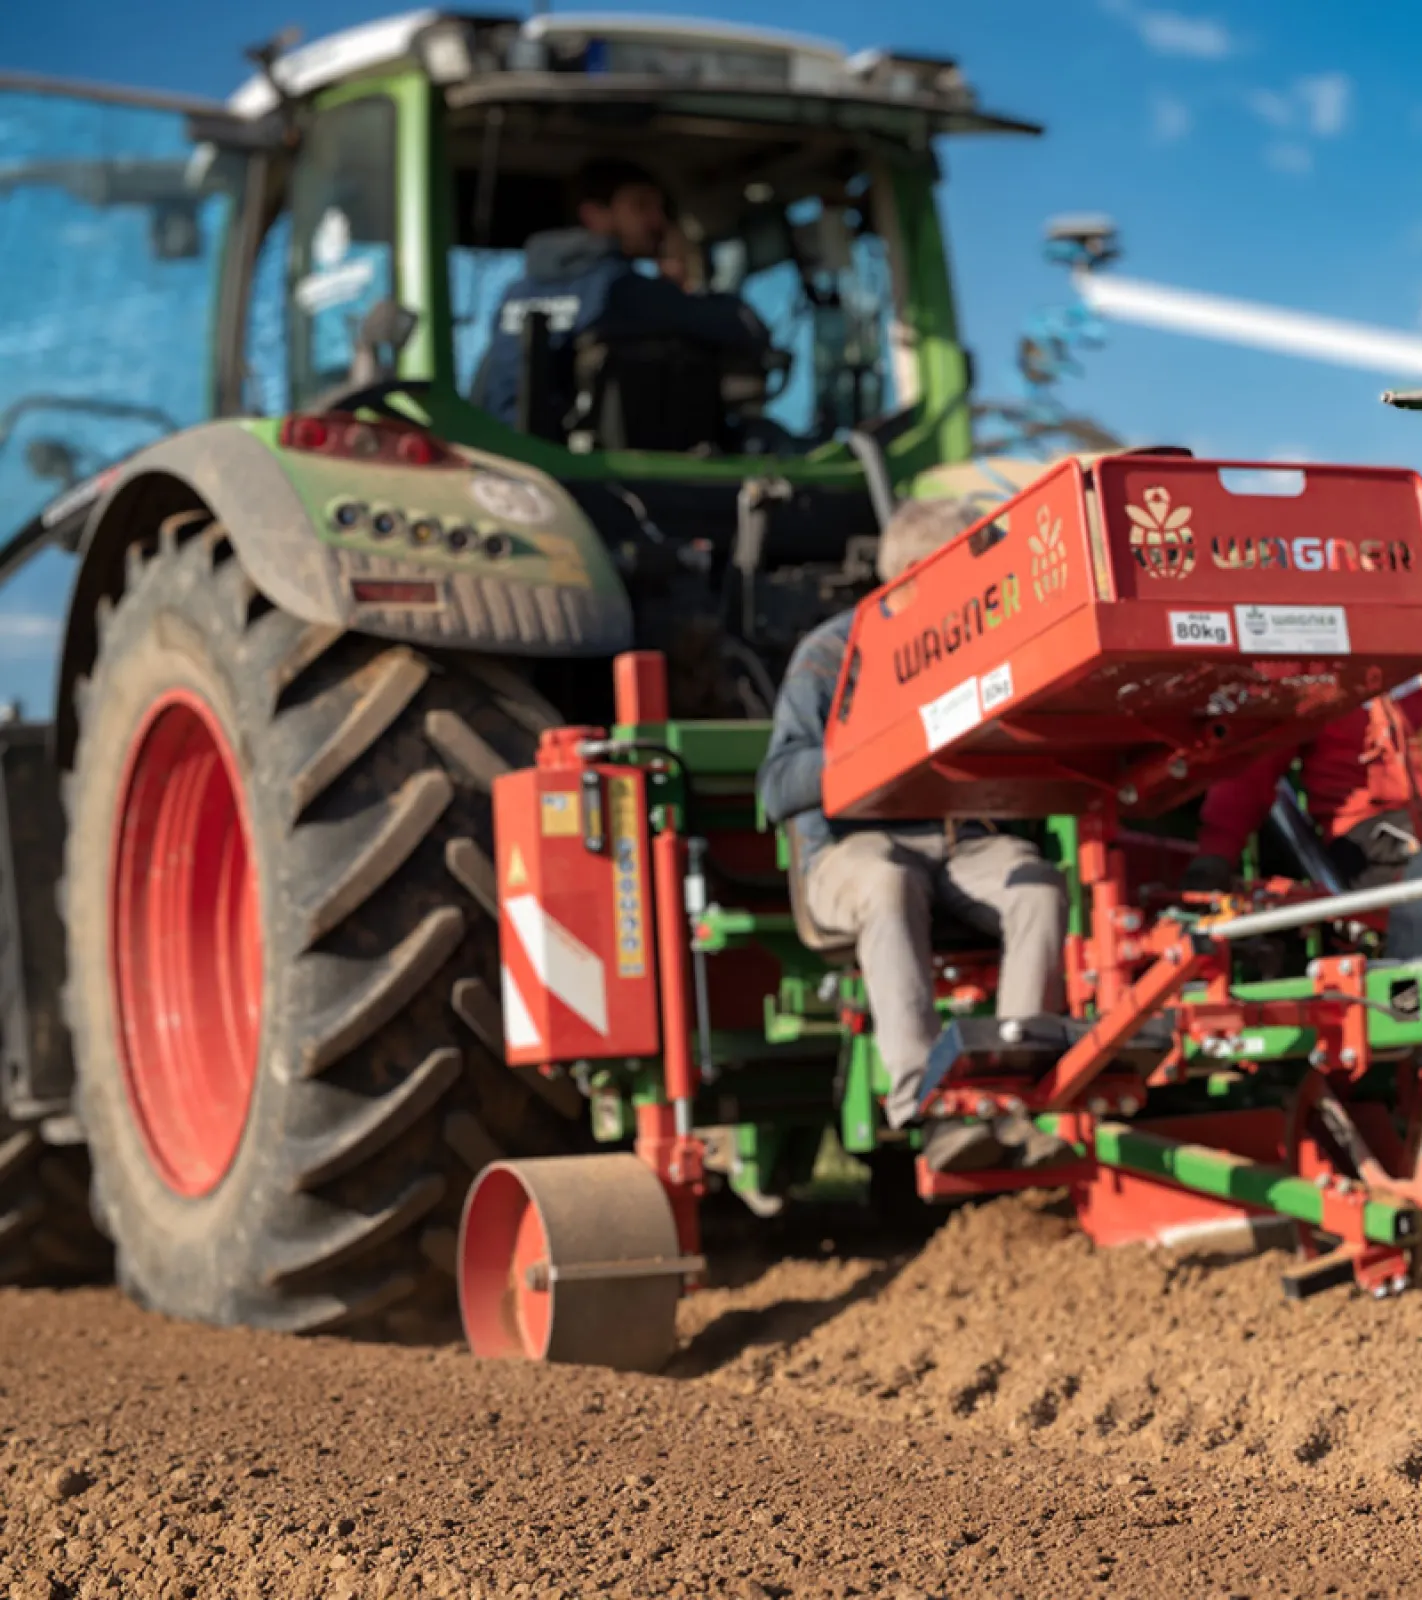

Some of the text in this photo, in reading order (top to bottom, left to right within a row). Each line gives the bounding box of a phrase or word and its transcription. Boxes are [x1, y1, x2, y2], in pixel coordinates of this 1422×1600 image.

[1211, 536, 1412, 571] WAGNER
[894, 572, 1020, 684] WAGNER
[1177, 623, 1226, 643] 80kg
